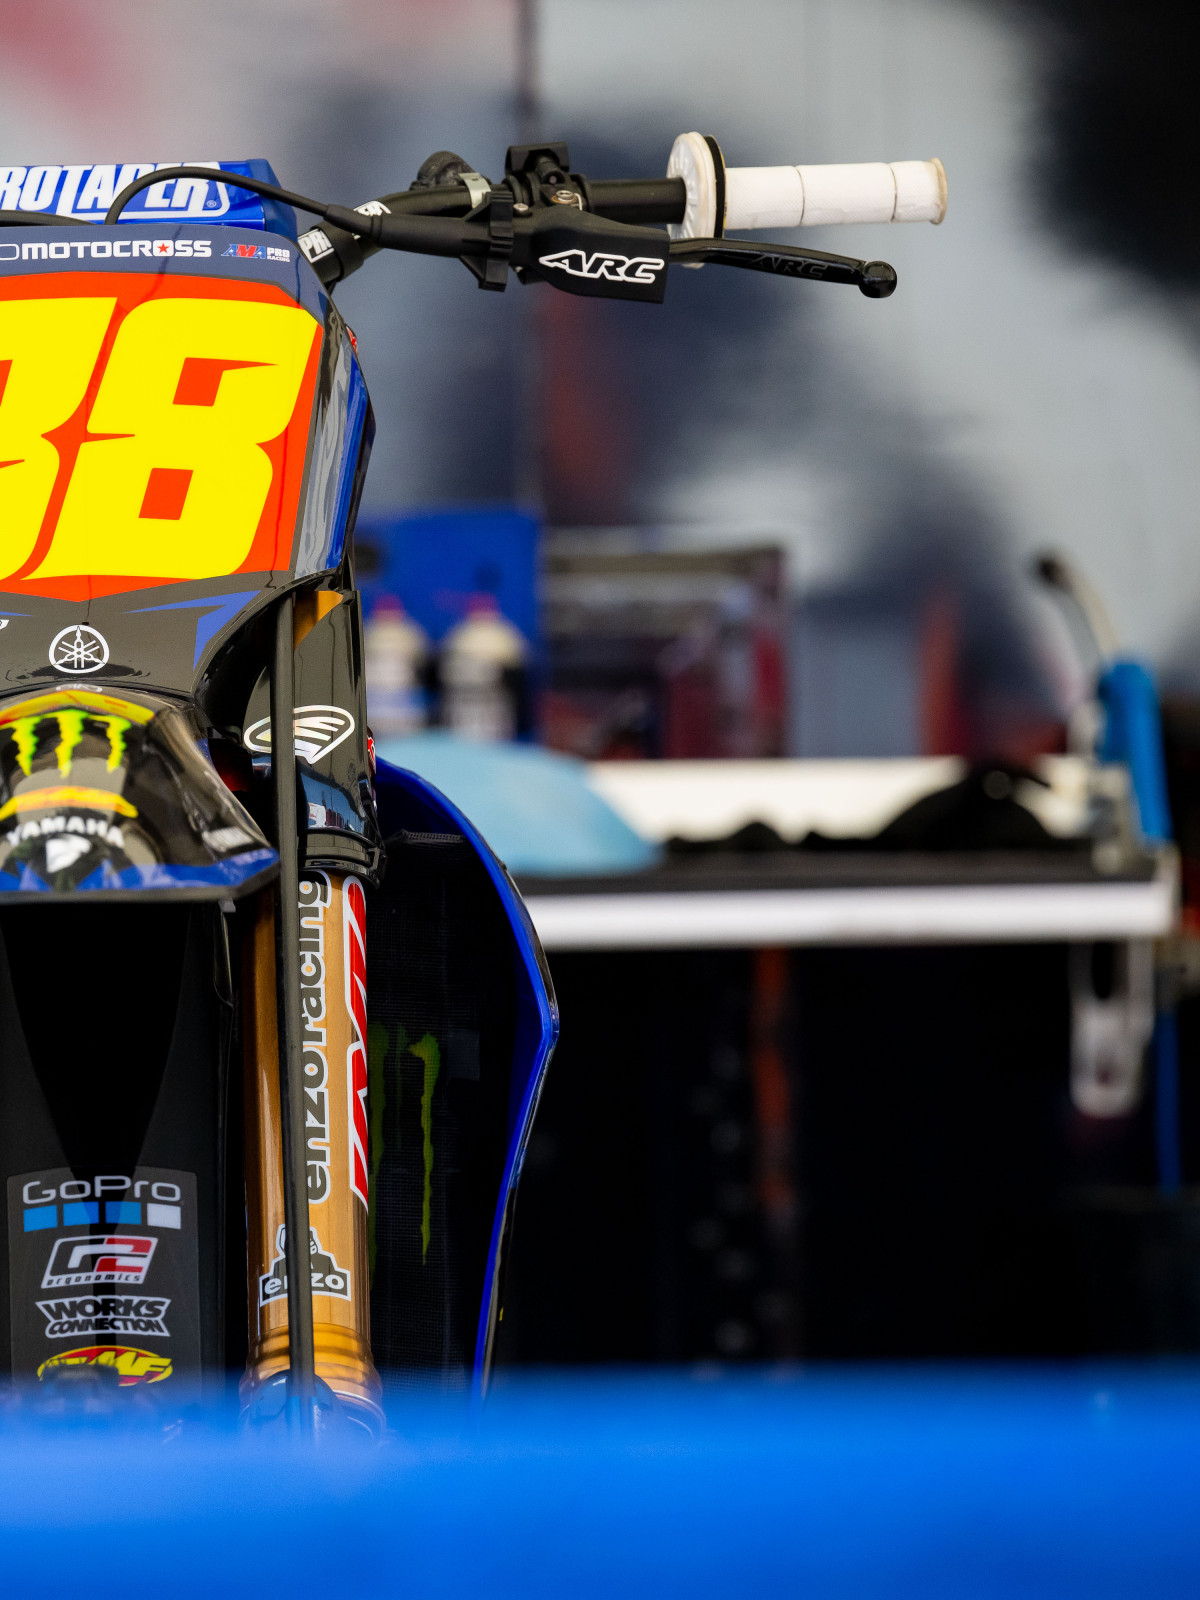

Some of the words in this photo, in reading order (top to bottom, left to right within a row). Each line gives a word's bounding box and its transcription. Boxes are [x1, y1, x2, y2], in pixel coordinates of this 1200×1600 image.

[221, 244, 266, 259] AMA
[267, 247, 290, 257] PRO
[266, 255, 291, 263] RACING
[539, 249, 665, 284] ARC
[748, 256, 829, 279] ARC
[6, 815, 126, 847] YAMAHA
[22, 1175, 181, 1205] GoPro
[264, 1272, 345, 1295] ezo
[41, 1298, 167, 1320] WORKS
[48, 1317, 165, 1335] CONNECTION
